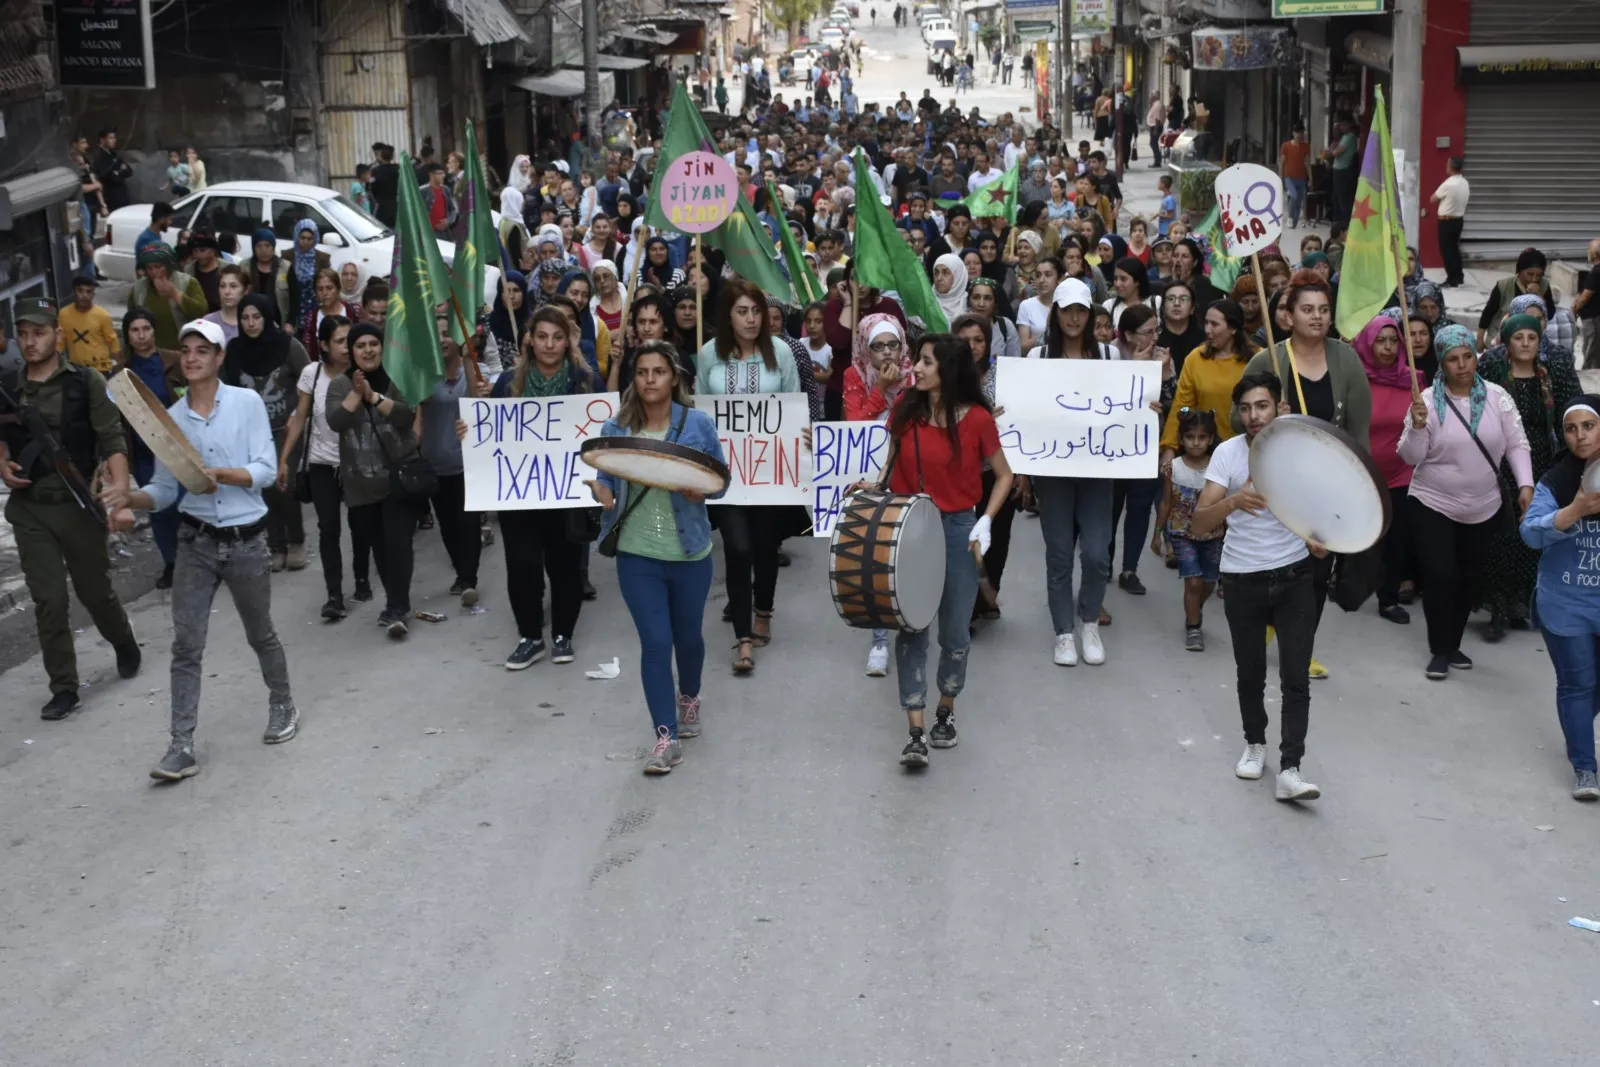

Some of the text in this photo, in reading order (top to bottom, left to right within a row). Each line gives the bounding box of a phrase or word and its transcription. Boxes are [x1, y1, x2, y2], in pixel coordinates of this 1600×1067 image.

[714, 394, 782, 434] HEMÛ
[1055, 374, 1144, 415] الموت
[472, 400, 564, 448] BIMRE
[493, 448, 581, 501] ÎXANE
